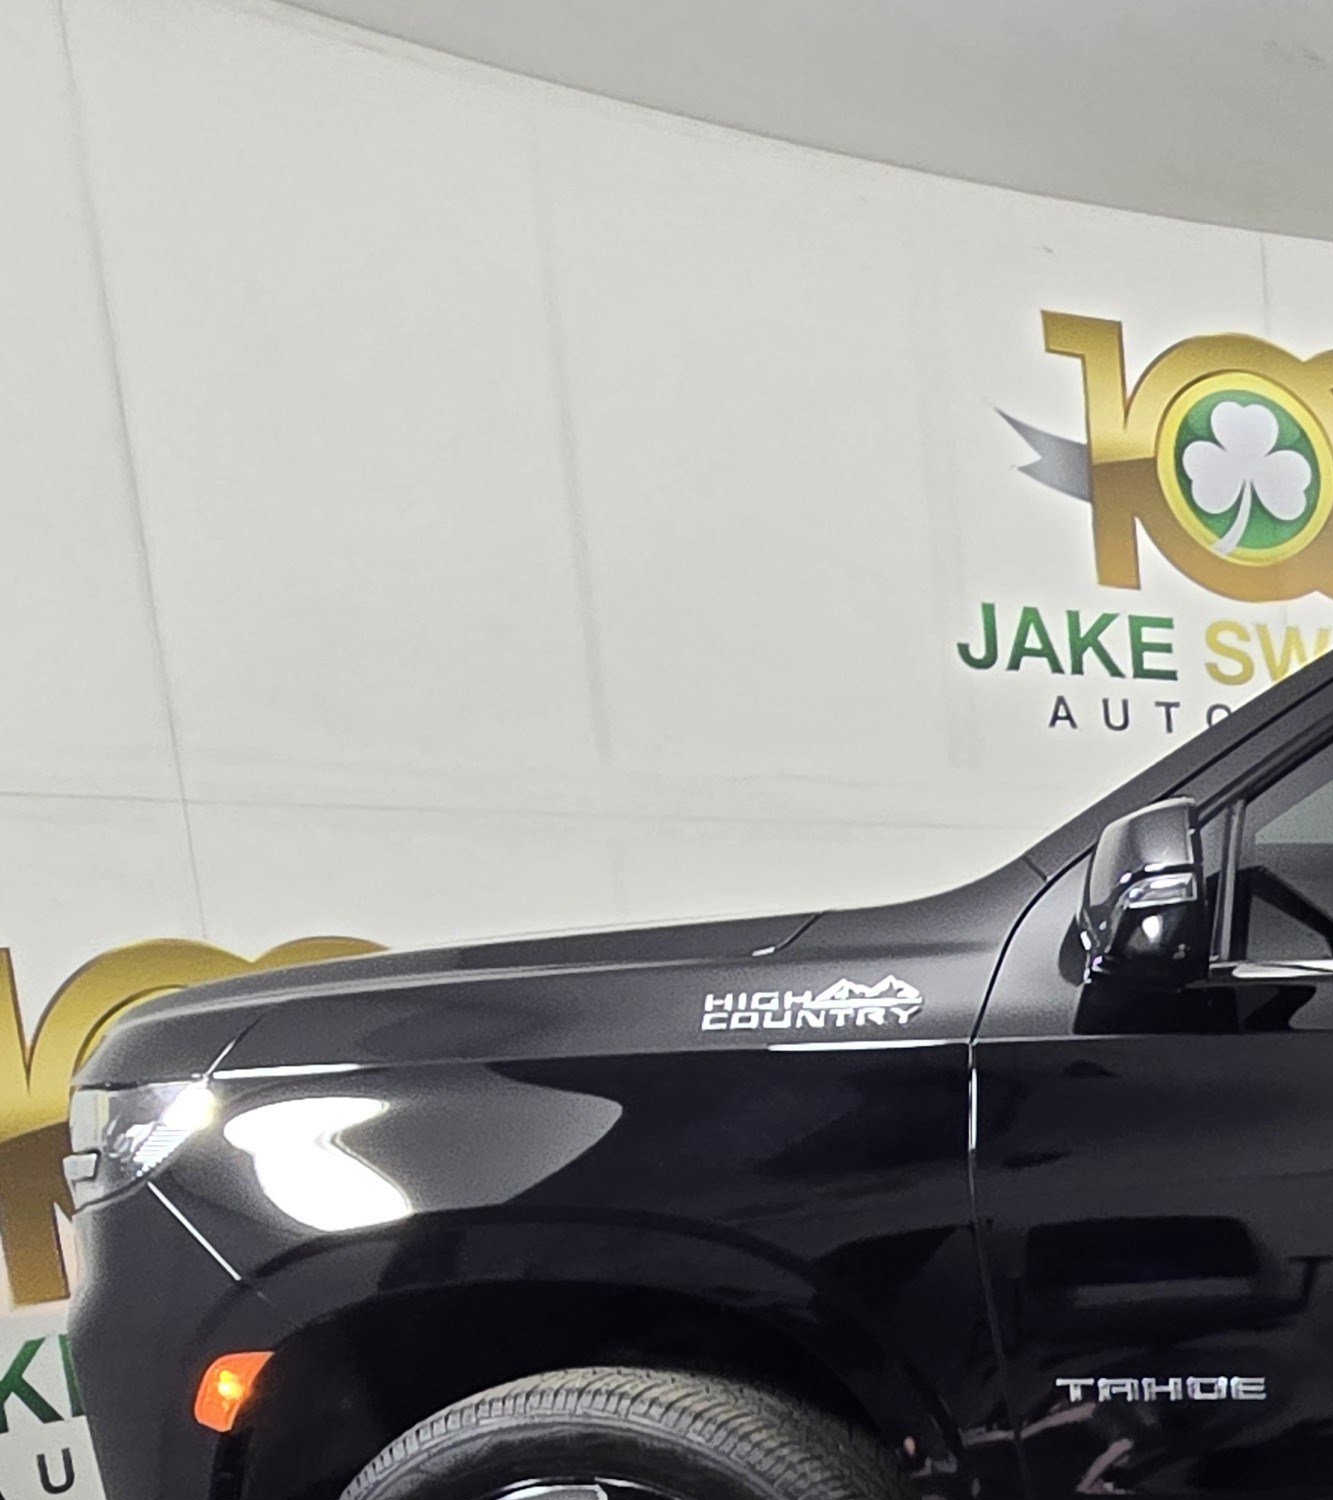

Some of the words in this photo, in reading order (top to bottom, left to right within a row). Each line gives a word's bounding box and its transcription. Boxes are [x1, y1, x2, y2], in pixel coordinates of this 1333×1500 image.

[956, 601, 1178, 682] JAKE
[704, 990, 813, 1011] HIGH
[701, 1006, 920, 1031] COUNTRY
[1055, 1376, 1267, 1402] TAHOE
